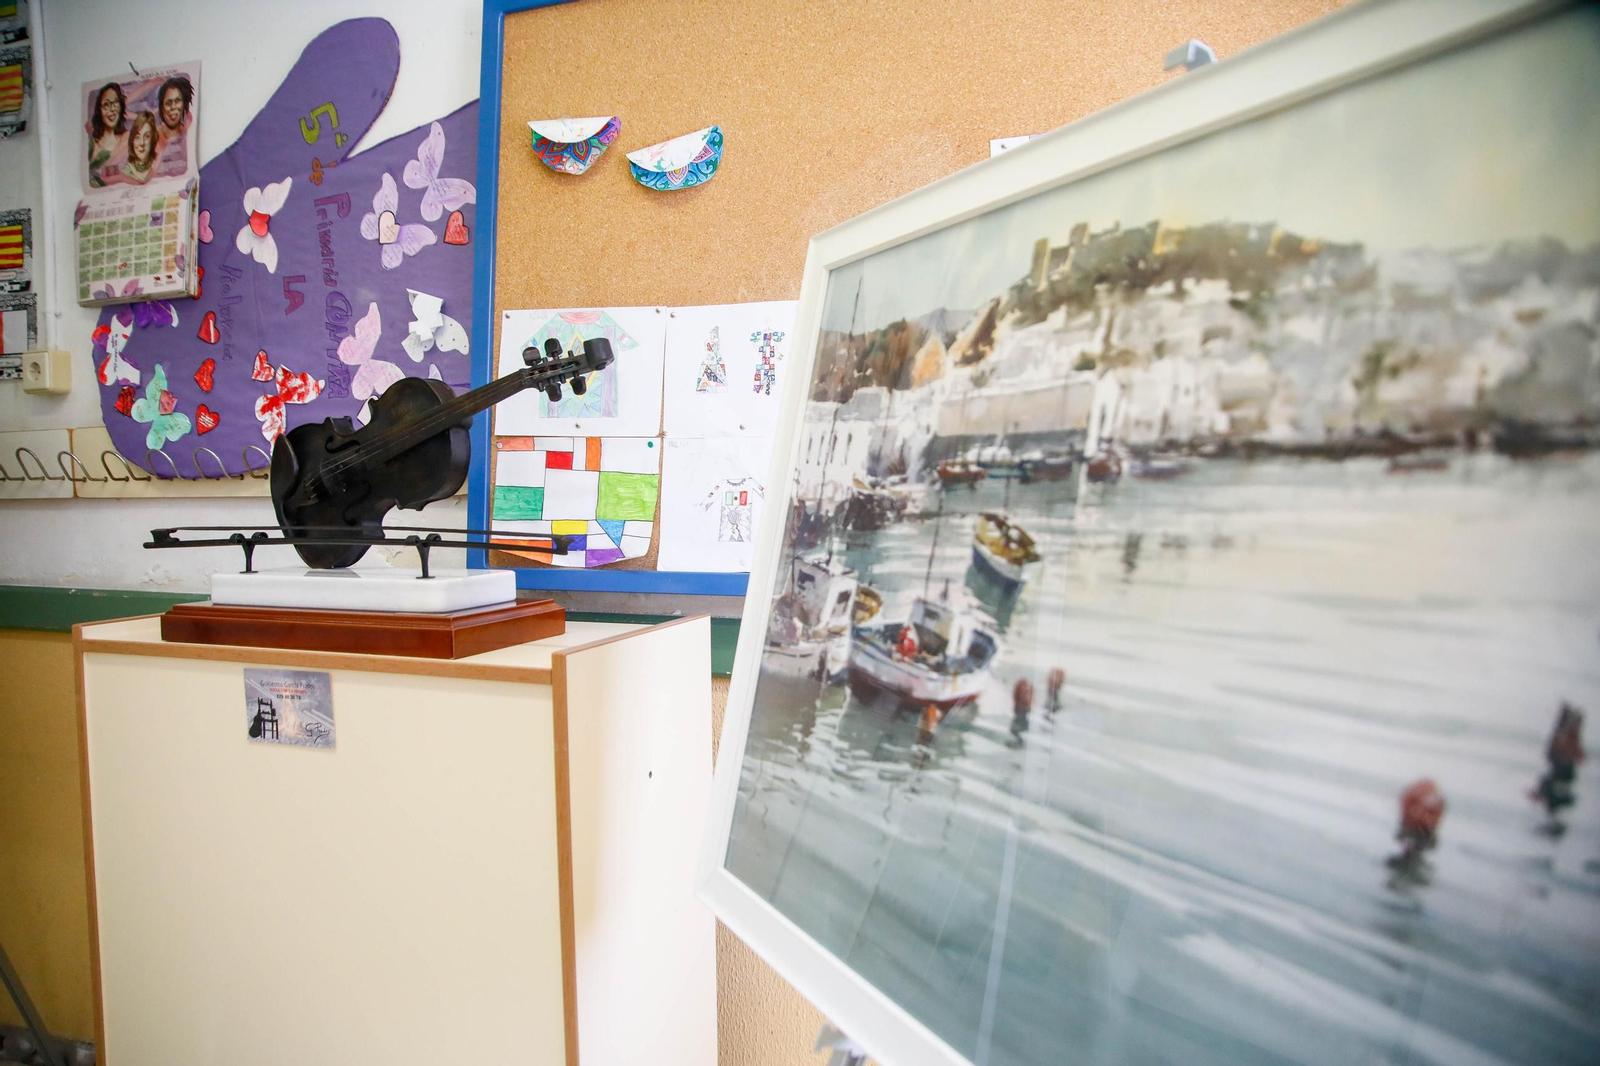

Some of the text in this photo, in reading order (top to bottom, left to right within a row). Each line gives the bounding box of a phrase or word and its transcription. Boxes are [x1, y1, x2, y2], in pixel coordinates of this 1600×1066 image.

[309, 157, 339, 186] de
[313, 192, 351, 288] Primaria
[218, 264, 243, 362] Violencia
[282, 275, 306, 316] LA
